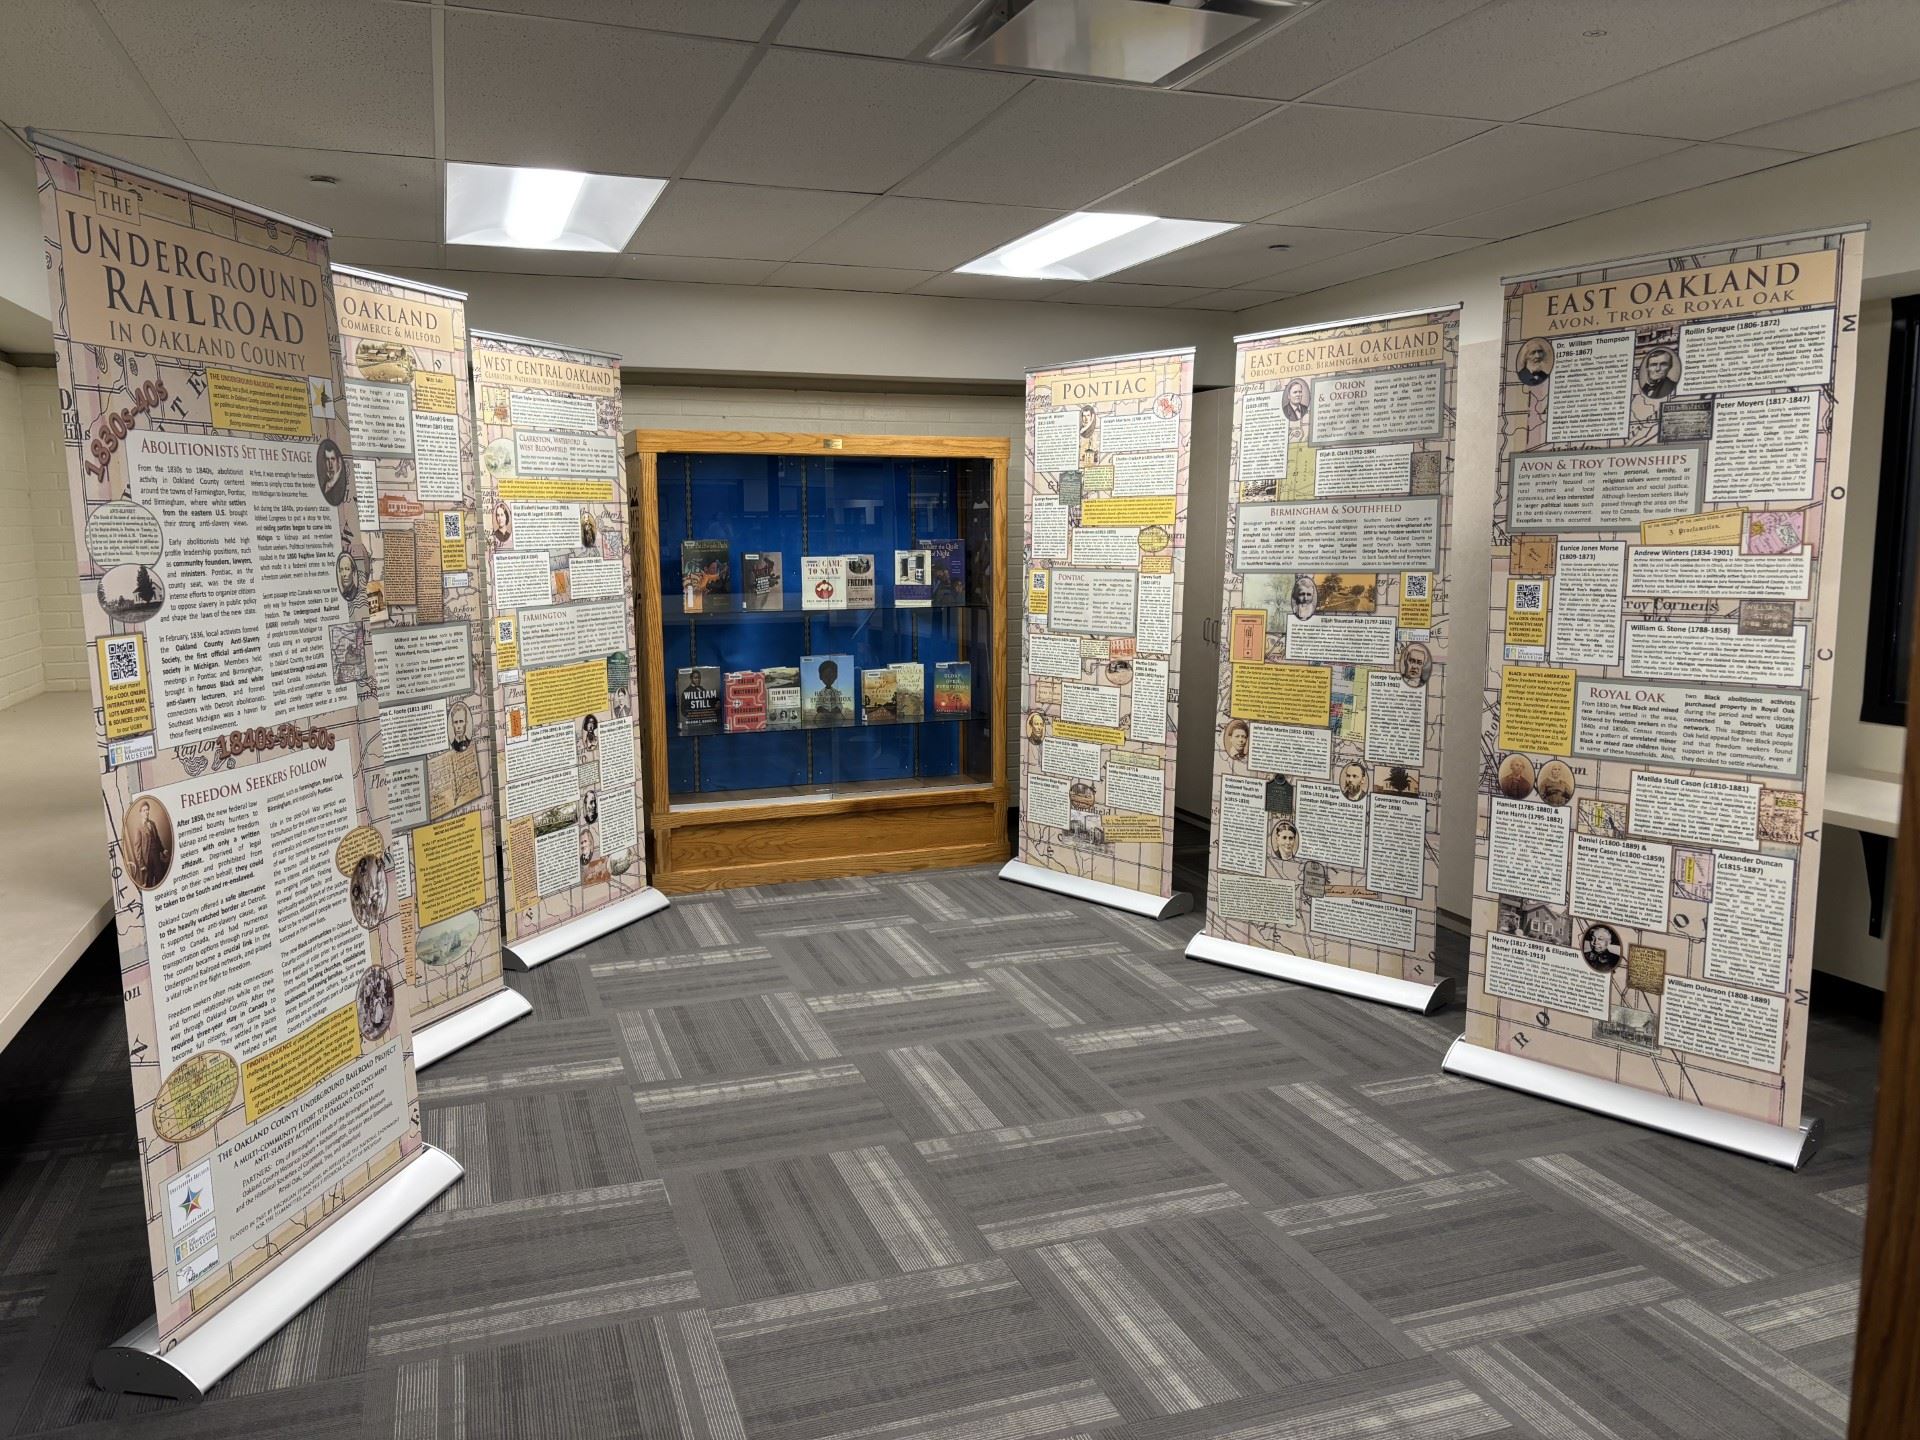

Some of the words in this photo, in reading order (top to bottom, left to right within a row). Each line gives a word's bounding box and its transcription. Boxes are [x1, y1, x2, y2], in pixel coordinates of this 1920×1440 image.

[99, 190, 132, 216] THE
[66, 209, 318, 308] UNDERGROUND
[1548, 288, 1617, 317] EAST
[1631, 262, 1800, 304] OAKLAND
[102, 265, 304, 345] RAILROAD
[343, 297, 438, 330] OAKLAND
[1549, 315, 1600, 330] AVON,
[1608, 307, 1654, 324] TROY
[1662, 303, 1675, 316] &
[1683, 295, 1744, 313] ROYAL
[1753, 290, 1795, 305] OAK
[340, 317, 392, 336] COMMERCE
[394, 327, 402, 338] &
[404, 329, 440, 344] MILFORD
[1685, 327, 1705, 336] Rollin
[1706, 325, 1735, 334] Sprague
[1736, 318, 1780, 332] (1806-1872)
[110, 320, 132, 342] IN
[142, 325, 236, 360] OAKLAND
[240, 343, 306, 372] COUNTY
[1250, 352, 1283, 369] EAST
[1287, 343, 1354, 364] CENTRAL
[1360, 331, 1439, 354] OAKLAND
[1569, 340, 1593, 348] William
[1596, 336, 1630, 344] Thompson
[1316, 356, 1370, 369] BIRMINGHAM
[1372, 354, 1380, 362] &
[1382, 347, 1436, 361] SOUTHFIELD
[484, 356, 512, 372] WEST
[516, 361, 562, 379] CENTRAL
[566, 368, 611, 386] OAKLAND
[1063, 377, 1146, 400] PONTIAC
[1334, 380, 1366, 390] ORION
[1318, 394, 1326, 402] &
[1329, 390, 1368, 401] OXFORD
[1737, 400, 1764, 408] Moyers
[1765, 395, 1810, 406] (1817-1847)
[84, 378, 169, 484] 1830s-40s
[142, 440, 239, 458] ABOLITIONISTS
[242, 445, 257, 459] SET
[258, 448, 279, 461] THE
[281, 448, 313, 463] STAGE
[1520, 461, 1553, 472] AVON
[1556, 460, 1566, 470] &
[1570, 458, 1604, 470] TROY
[1607, 454, 1688, 468] TOWNSHIPS
[1270, 507, 1329, 517] BIRMINGHAM
[1331, 506, 1339, 515] &
[1342, 504, 1402, 514] SOUTHFIELD
[1690, 549, 1734, 557] (1834-1901)
[1058, 573, 1085, 582] PONTIAC
[1626, 601, 1653, 613] roy
[523, 611, 567, 622] FARMINGTON
[1631, 624, 1655, 632] William
[1794, 988, 1809, 1006] M
[1804, 830, 1820, 842] A
[1818, 648, 1833, 661] C
[1831, 486, 1846, 500] O
[1842, 314, 1858, 332] M
[684, 690, 717, 700] WILLIAM
[1590, 687, 1631, 701] ROYAL
[1636, 690, 1665, 703] OAK
[690, 700, 711, 709] STILL
[181, 784, 242, 808] FREEDOM
[246, 770, 288, 790] SEEKERS
[290, 758, 327, 778] FOLLOW
[1637, 775, 1662, 783] Matilda
[1664, 777, 1679, 785] Stull
[1680, 779, 1701, 787] Cason
[1510, 811, 1527, 819] Harris
[1578, 836, 1598, 844] Daniel
[1578, 844, 1598, 854] Betsey
[1600, 847, 1618, 856] Cason
[1718, 853, 1754, 864] Alexander
[1756, 858, 1783, 868] Duncan
[1492, 936, 1509, 945] Henry
[1552, 947, 1579, 959] Elizabeth
[1668, 978, 1694, 989] William
[1695, 984, 1726, 996] Dolarson
[218, 1148, 232, 1162] THE
[234, 1127, 269, 1152] OAKLAND
[270, 1109, 299, 1130] COUNTY
[300, 1078, 345, 1111] UNDERGROUND
[346, 1060, 374, 1081] RAILROAD
[375, 1045, 396, 1063] PROJECT
[240, 1126, 297, 1164] MULTI-COMMUNITY
[298, 1112, 316, 1128] EFFORT
[317, 1107, 324, 1115] TO
[324, 1090, 349, 1110] RESEARCH
[349, 1083, 361, 1095] AND
[361, 1066, 387, 1086] DOCUMENT
[255, 1136, 295, 1165] ANTI-SLAVERY
[296, 1118, 322, 1140] ACTIVITIES
[322, 1113, 329, 1121] IN
[329, 1097, 353, 1116] OAKLAND
[354, 1083, 374, 1099] COUNTY
